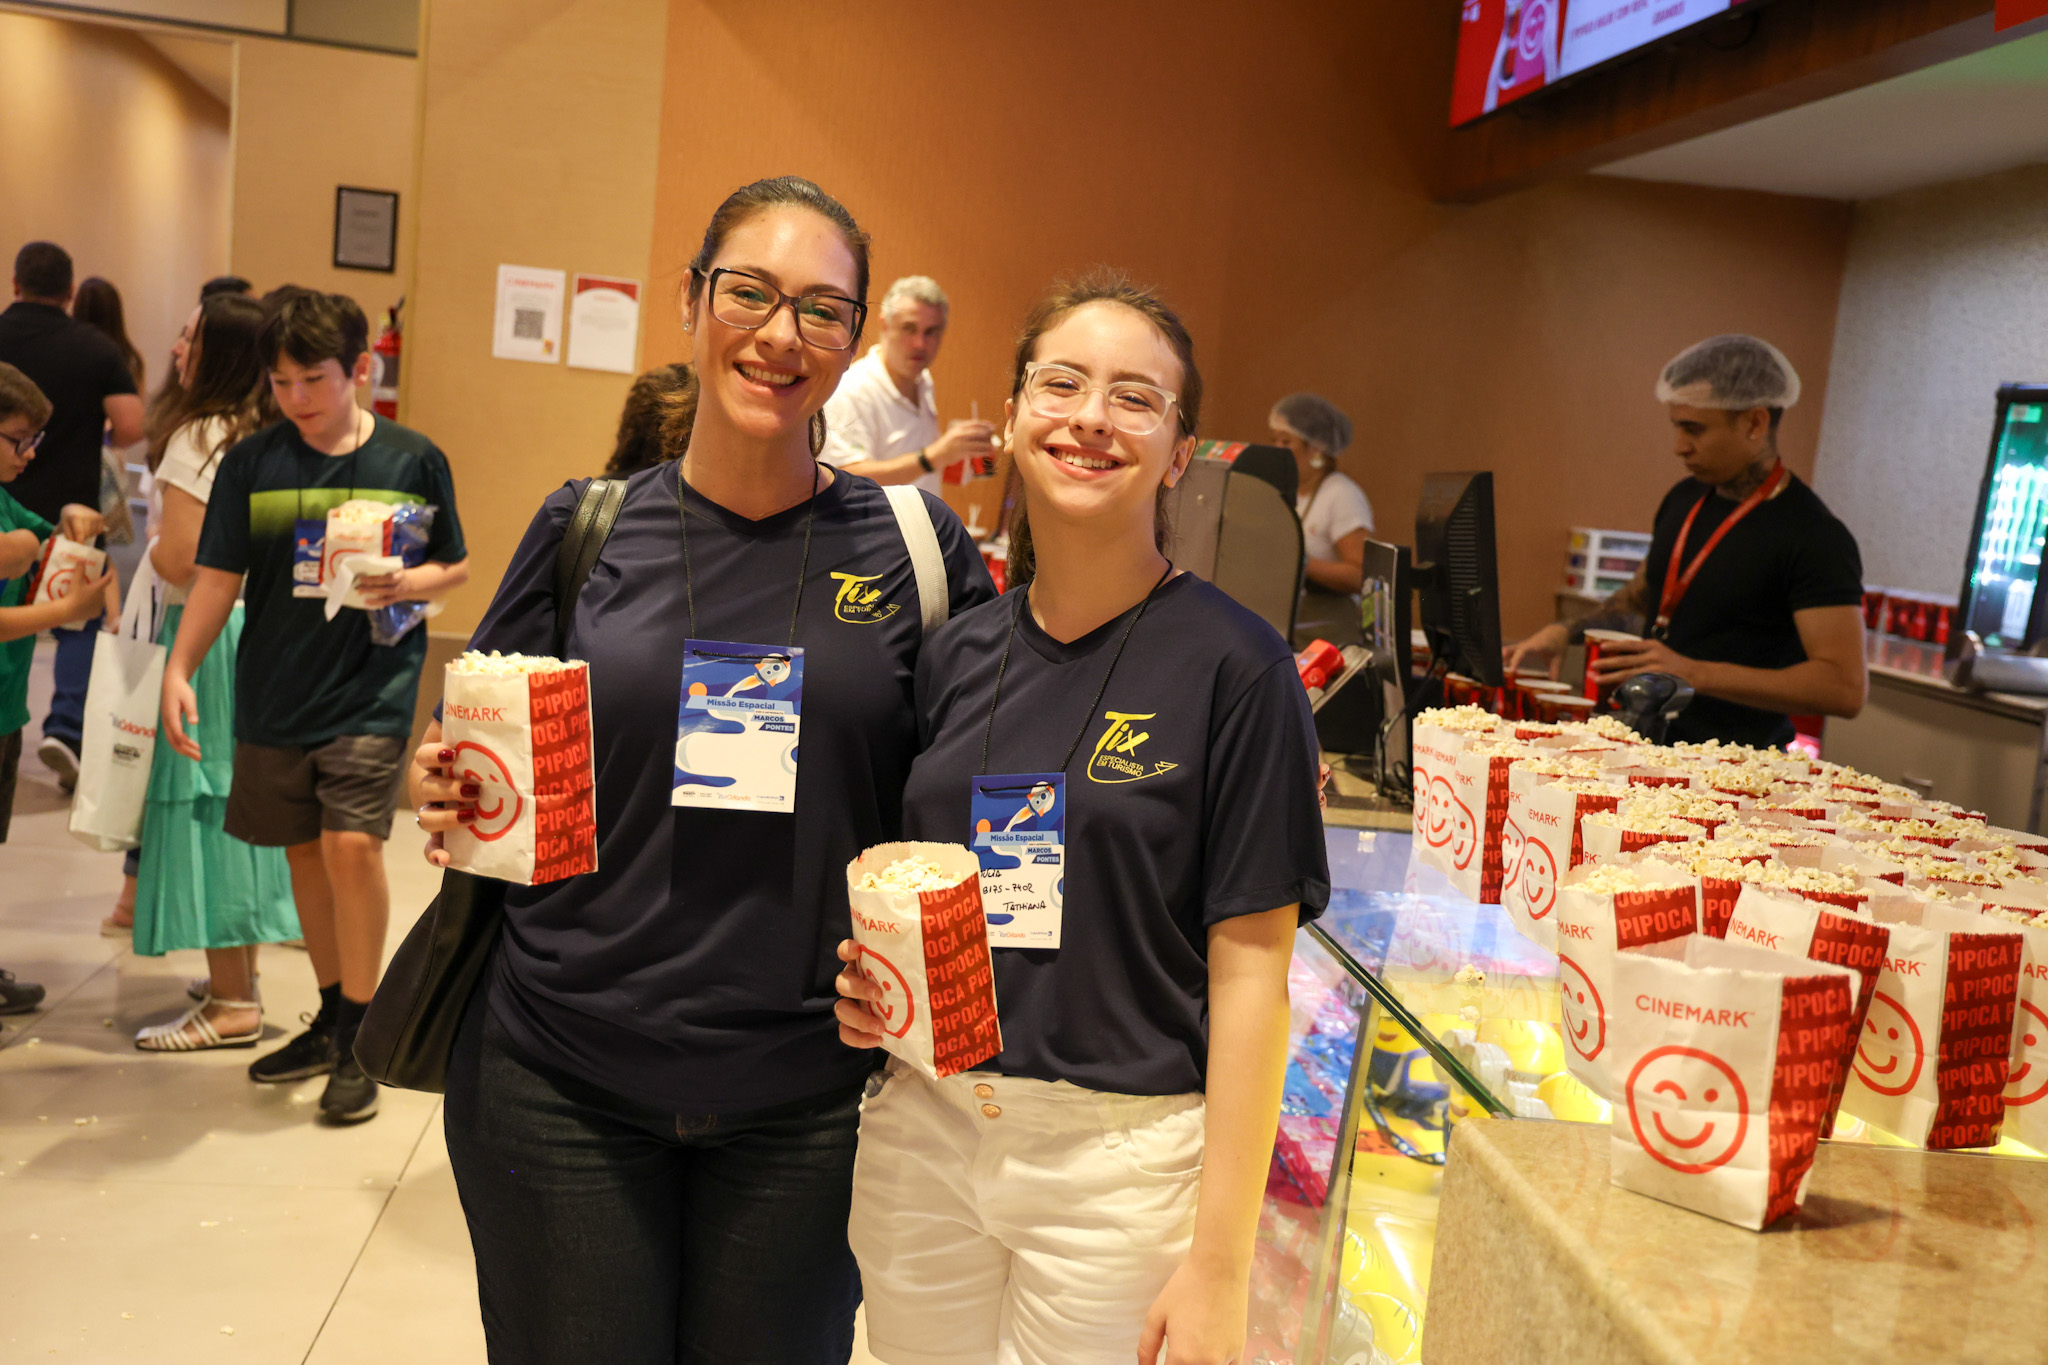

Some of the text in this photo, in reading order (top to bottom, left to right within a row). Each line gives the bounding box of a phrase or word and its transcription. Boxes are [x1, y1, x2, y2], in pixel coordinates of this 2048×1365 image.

[830, 571, 883, 605] Tix
[532, 684, 587, 718] PIPOCA
[707, 698, 775, 711] Missão Espacial
[533, 719, 569, 746] OCA
[754, 715, 785, 723] MARCOS
[765, 724, 794, 732] PONTES
[1095, 711, 1157, 757] Tix
[533, 741, 589, 777] PIPOCA
[1100, 755, 1144, 772] ESPECIALISTA
[1108, 760, 1143, 777] TURISMO
[536, 800, 591, 834] PIPOCA
[536, 835, 569, 861] OCA
[990, 833, 1044, 843] Missão Espacial
[533, 853, 590, 885] PIPOCA
[1036, 855, 1059, 864] PONTES
[923, 891, 980, 934] PIPOCA
[1618, 906, 1693, 940] PIPOCA
[925, 931, 960, 958] OCA
[1813, 938, 1883, 968] PIPOCA
[926, 943, 984, 985] PIPOCA
[930, 966, 989, 1010] OCA PIP
[932, 995, 989, 1037] PIPOCA
[1635, 994, 1749, 1029] CINEMARK
[935, 1033, 970, 1058] OCA
[936, 1042, 995, 1079] PIPOCA
